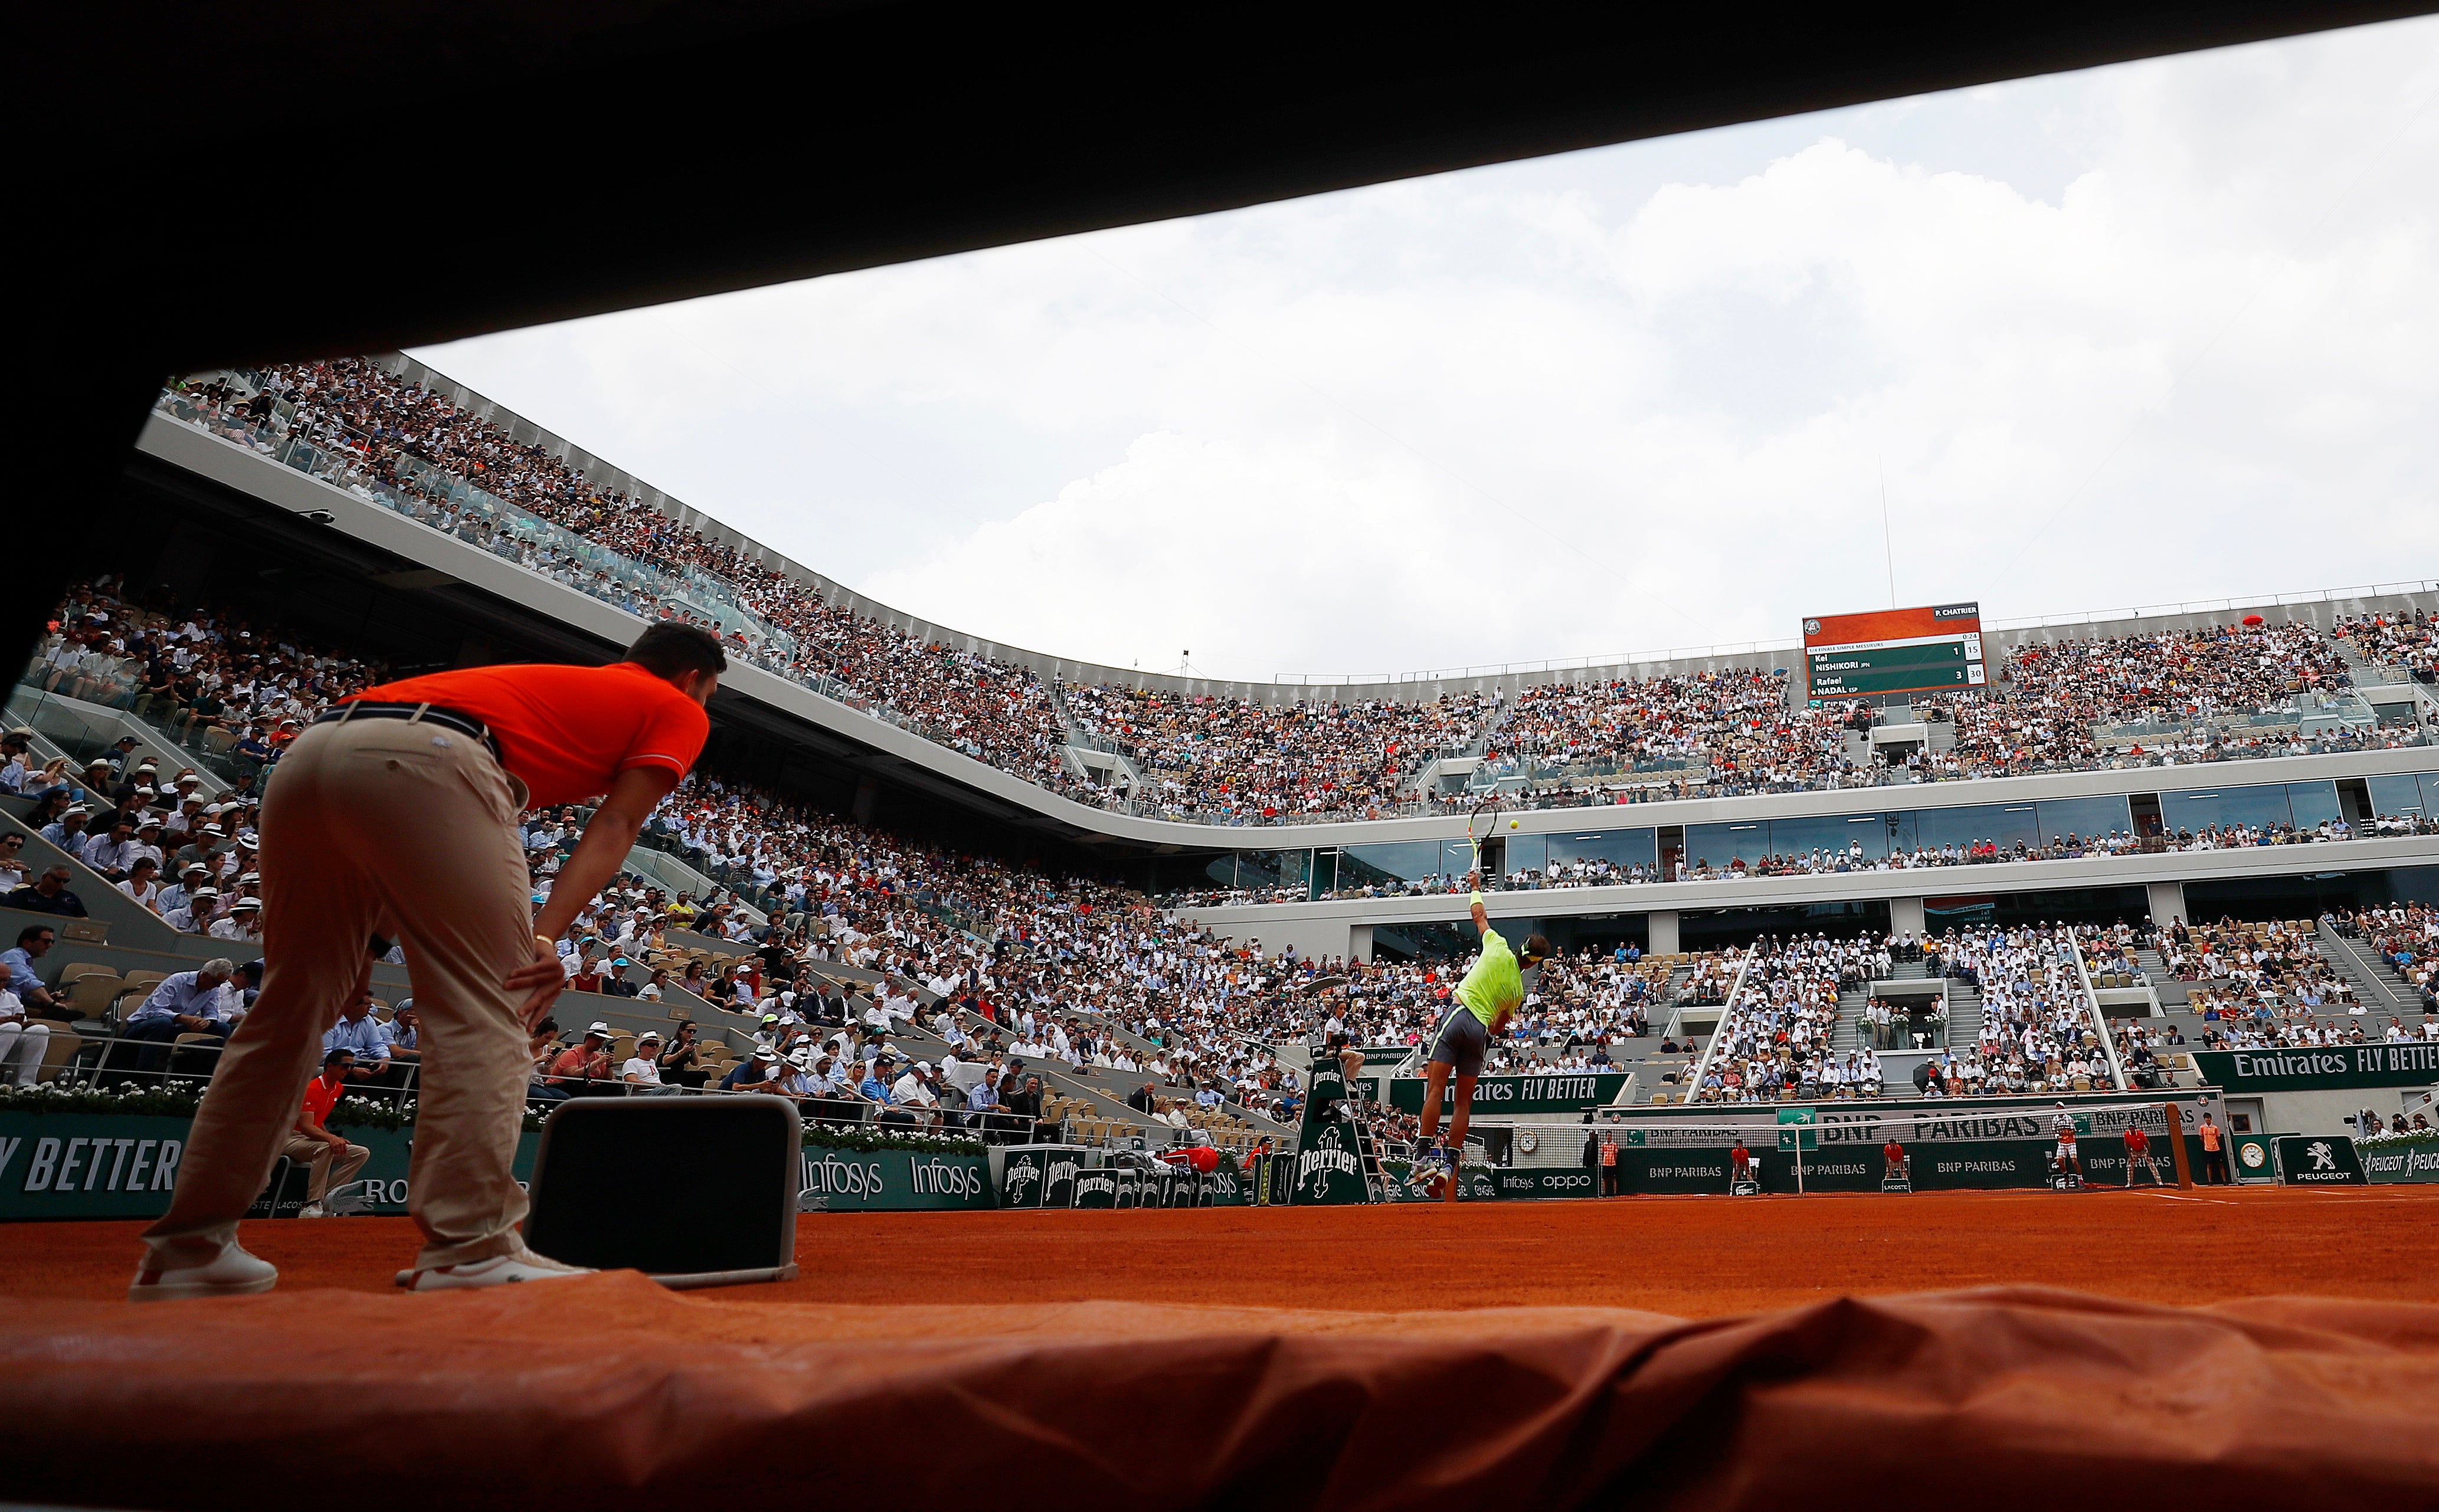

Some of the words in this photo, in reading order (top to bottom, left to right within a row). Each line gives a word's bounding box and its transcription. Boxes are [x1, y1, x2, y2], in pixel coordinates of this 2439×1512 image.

[1942, 607, 1977, 616] CHATRIER
[1953, 647, 1959, 655] 1
[1815, 654, 1828, 662] Kei
[1815, 661, 1858, 672] NISHIKORI
[1816, 676, 1842, 686] Rafael
[1817, 686, 1847, 696] NADAL
[2232, 1051, 2347, 1077] Emirates
[2356, 1048, 2383, 1072] FLY
[2388, 1046, 2439, 1071] BETTE
[1521, 1078, 1546, 1100] FLY
[1547, 1077, 1596, 1100] BETTER
[1913, 1111, 2041, 1139] PARIBAS
[24, 1137, 181, 1190] BETTER
[1937, 1162, 1962, 1173] BNP
[1965, 1160, 2016, 1172] PARIBAS
[2090, 1158, 2116, 1169] BNP
[2371, 1156, 2404, 1172] PEUGEOT
[1649, 1167, 1672, 1178] BNP
[1675, 1167, 1721, 1178] PARIBAS
[1790, 1165, 1815, 1176] BNP
[1818, 1164, 1866, 1175] PARIBAS
[2297, 1172, 2351, 1180] PEUGEOT
[800, 1152, 883, 1201] Infosys
[911, 1156, 981, 1201] Infosys
[1503, 1176, 1534, 1190] Infosys
[1542, 1175, 1591, 1190] oppo
